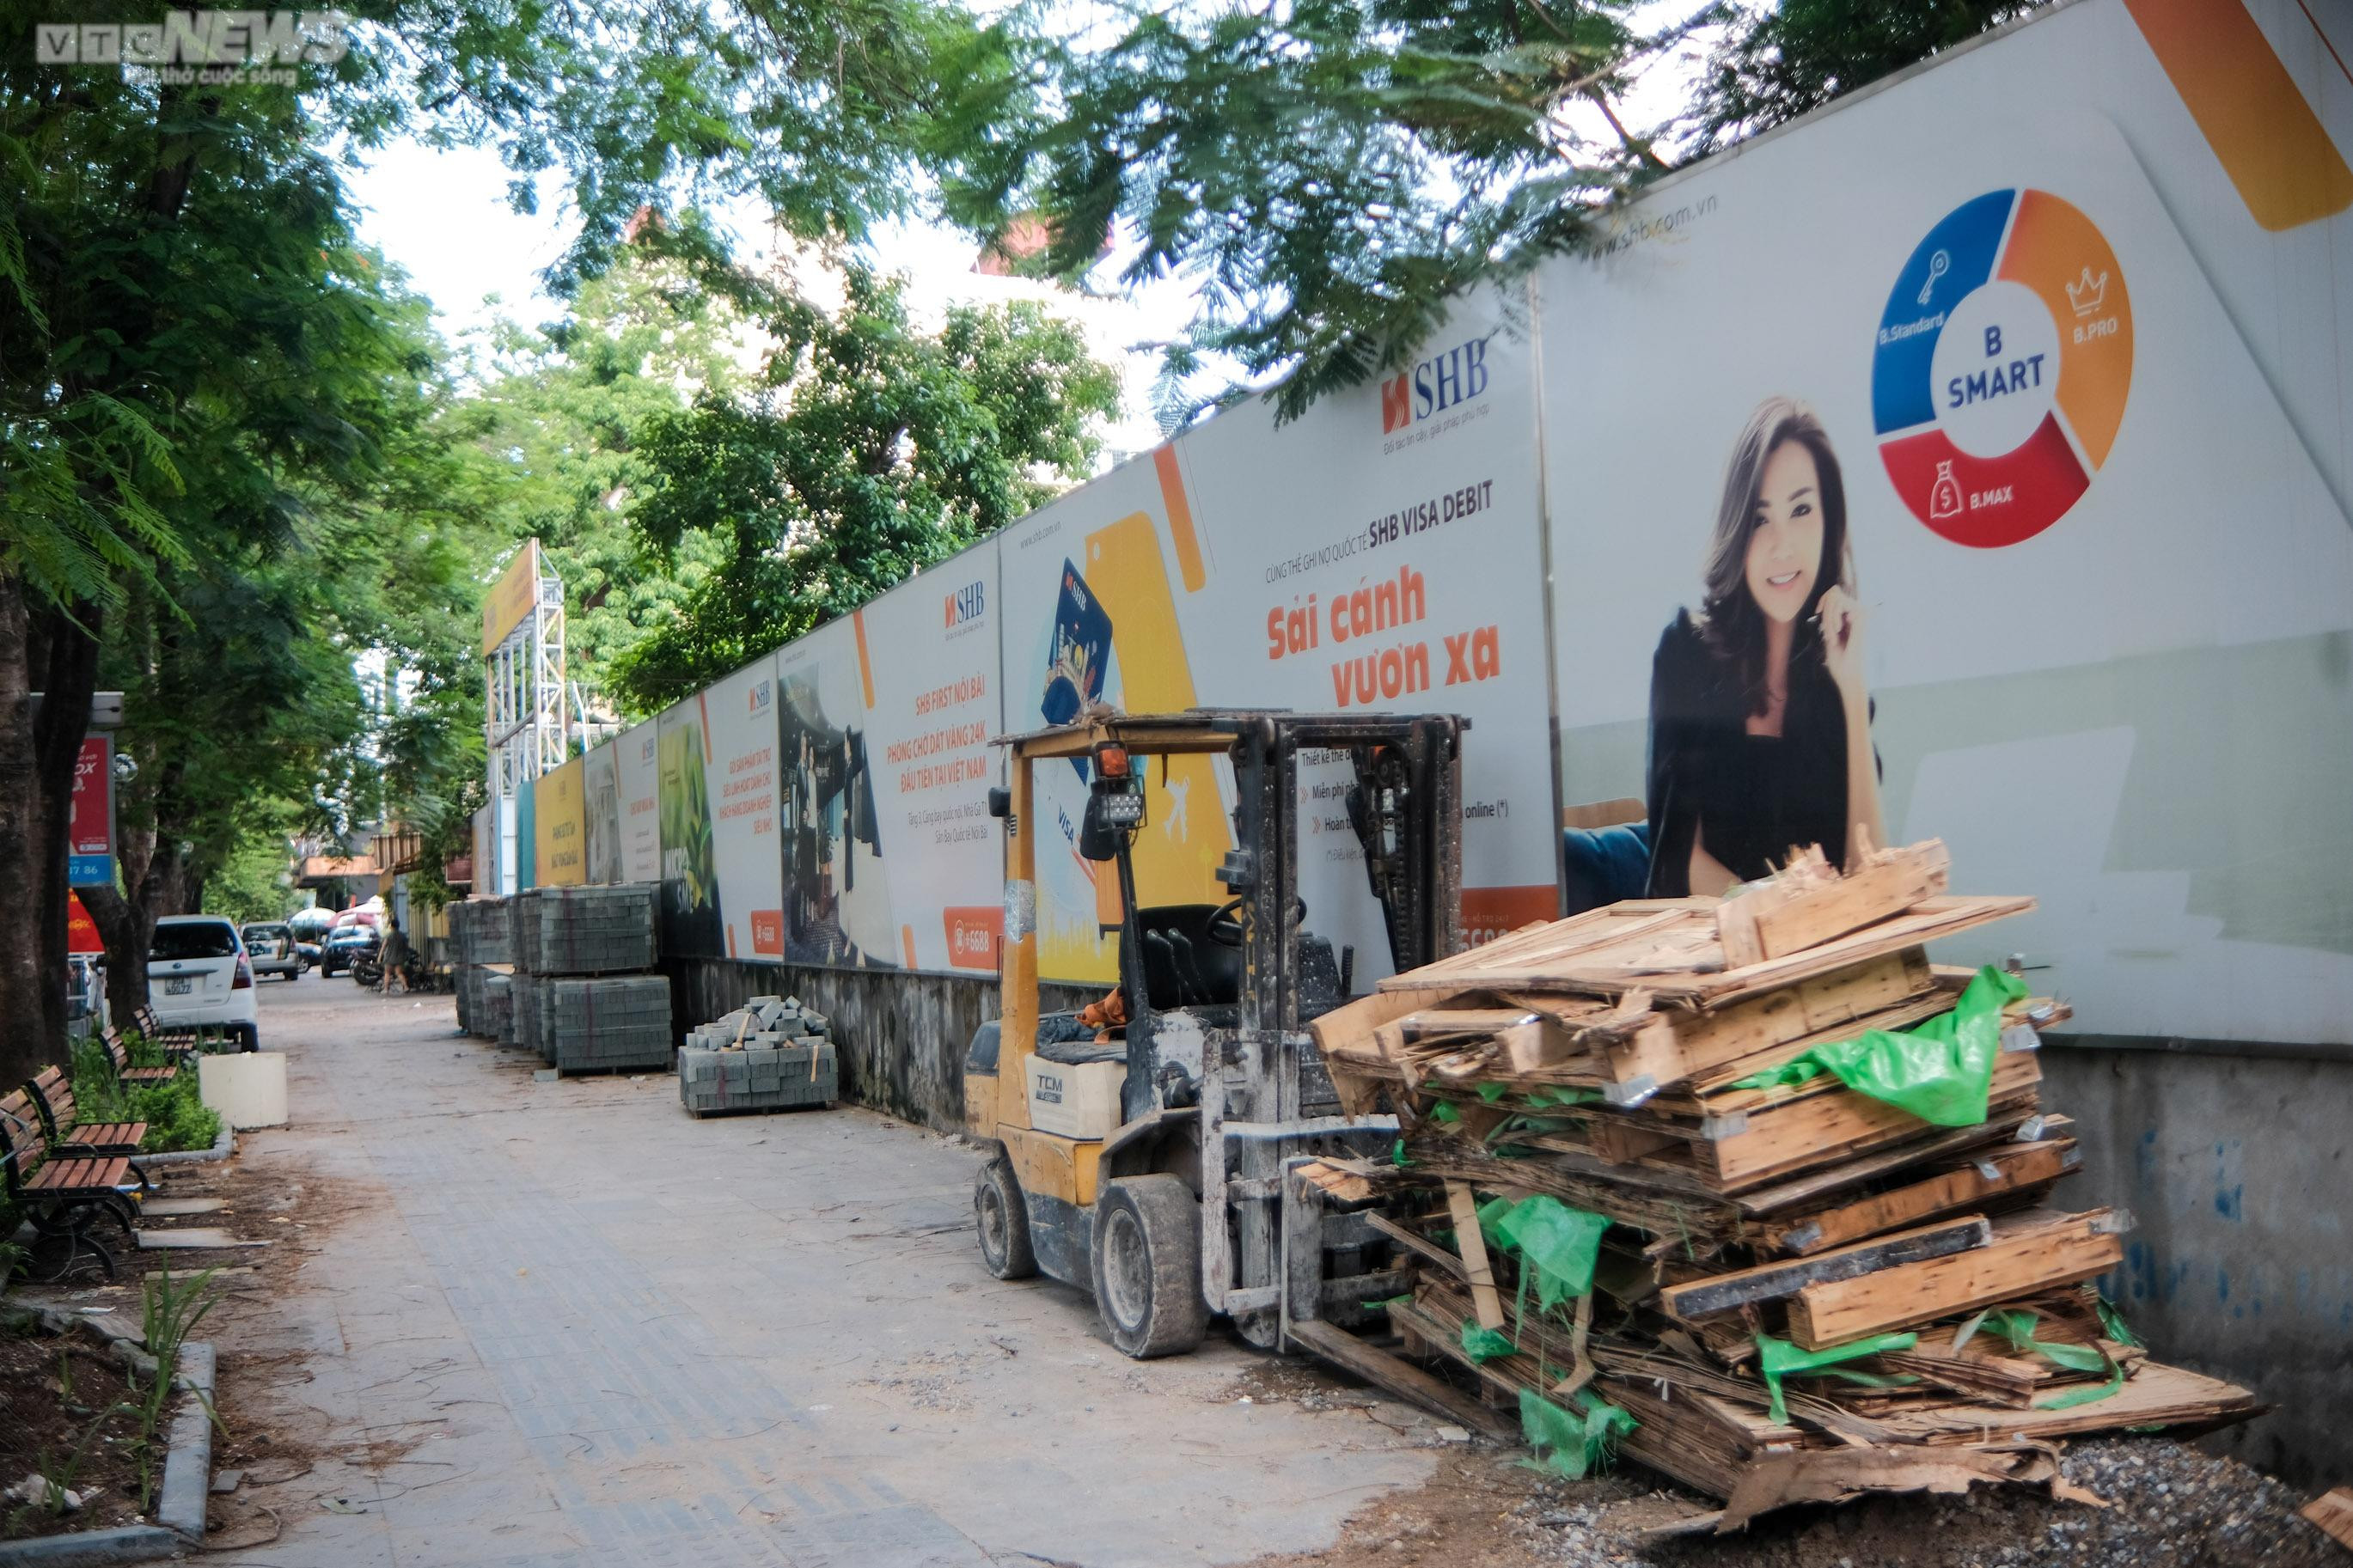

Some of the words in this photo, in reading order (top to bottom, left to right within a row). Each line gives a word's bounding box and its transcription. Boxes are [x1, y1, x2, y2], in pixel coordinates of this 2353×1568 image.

[1879, 311, 1946, 345] B.Standard
[1984, 326, 2002, 358] B
[2074, 317, 2118, 345] B.PRO
[1415, 338, 1488, 420] SHB
[1948, 354, 2044, 409] SMART
[1971, 485, 2014, 509] B.MAX
[1266, 563, 1287, 583] CÙNG
[1304, 553, 1317, 570] GHI
[1318, 544, 1330, 567] NỢ
[1332, 533, 1357, 561] QUỐC
[1358, 528, 1369, 552] TẾ
[1369, 514, 1399, 548] SHB
[1402, 499, 1440, 536] VISA
[1443, 479, 1494, 523] DEBIT
[957, 580, 984, 624] SHB
[1072, 580, 1087, 612] SHB
[1268, 593, 1319, 660] Sải
[1330, 564, 1427, 644] cánh
[1331, 641, 1431, 708] vươn
[1443, 625, 1500, 686] xa
[756, 680, 770, 710] SHB
[915, 692, 931, 716] SHB
[932, 686, 953, 711] FIRST
[887, 738, 912, 765] PHÒNG
[946, 723, 969, 749] VÀNG
[970, 720, 987, 745] 24K
[917, 764, 933, 790] TIÊN
[948, 757, 965, 789] VIỆT
[966, 754, 987, 780] NAM
[1312, 782, 1330, 799] Miễn
[1059, 806, 1073, 845] VISA
[1325, 816, 1345, 831] Hoàn
[1465, 802, 1494, 819] online
[1036, 1074, 1062, 1092] TCM
